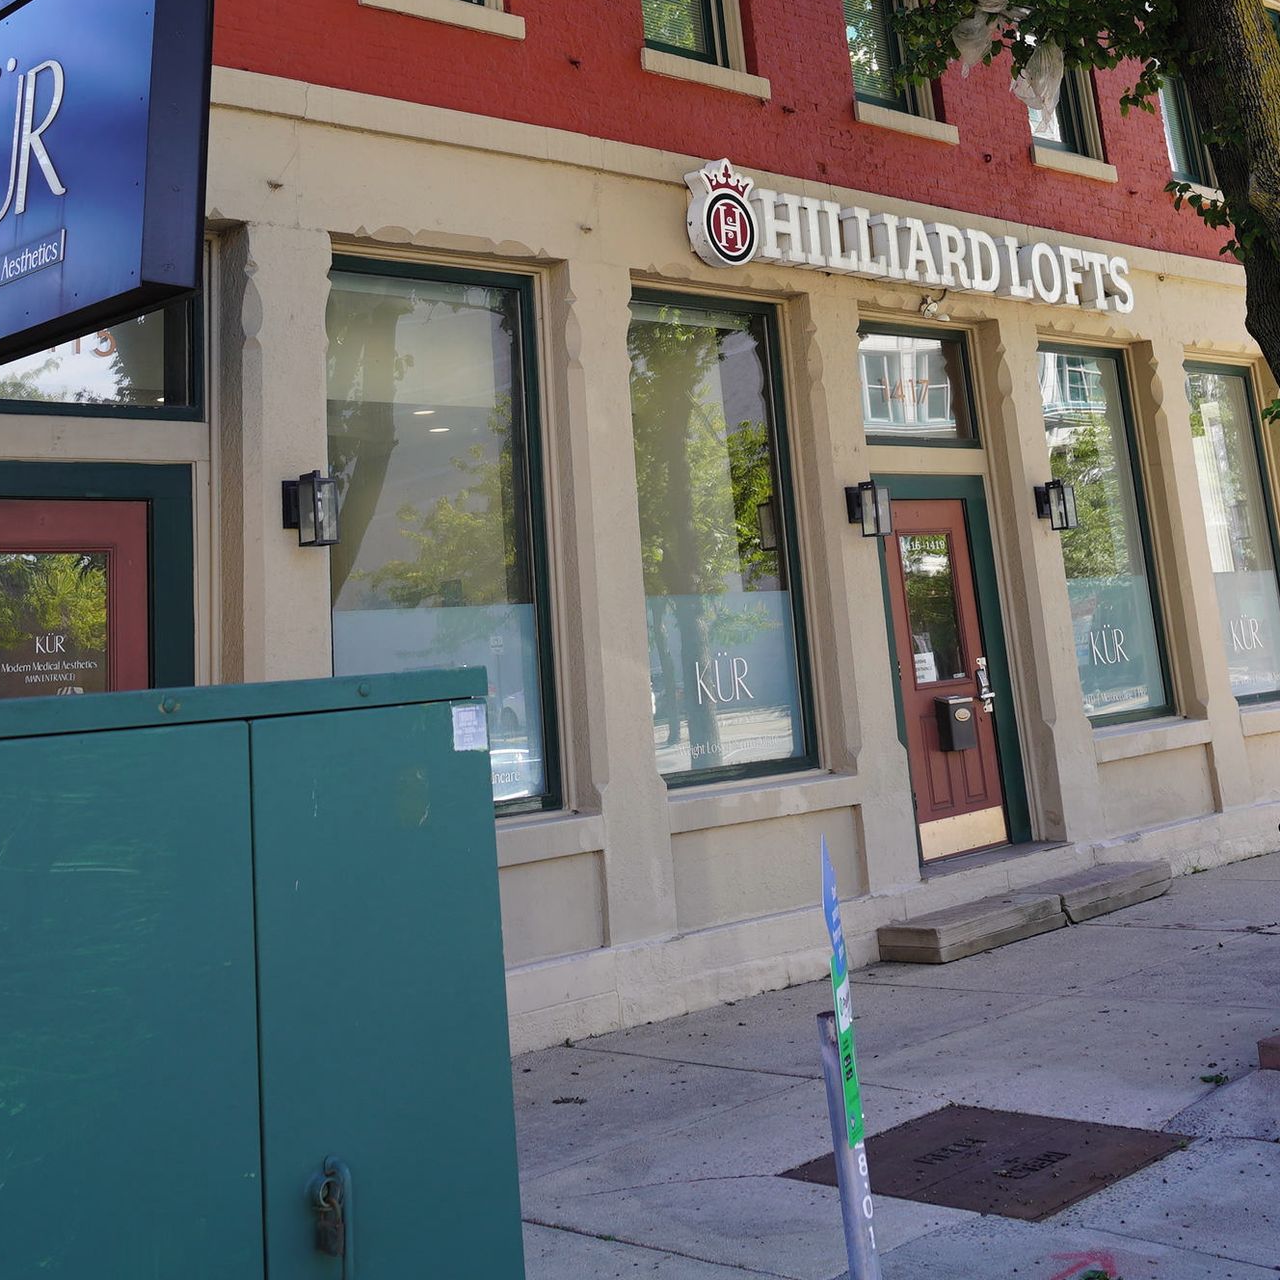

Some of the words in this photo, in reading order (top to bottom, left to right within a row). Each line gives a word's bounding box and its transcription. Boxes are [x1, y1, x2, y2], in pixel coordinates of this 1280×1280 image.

[0, 241, 59, 281] Aesthetics
[755, 188, 1001, 293] HILLIARD
[998, 235, 1134, 314] LOFTS
[35, 632, 66, 654] KÜR
[1089, 624, 1130, 666] KÜR
[1230, 614, 1264, 652] KÜR
[1, 663, 31, 673] Modern
[32, 660, 60, 671] Medical
[61, 659, 98, 670] Aesthetics
[695, 651, 754, 705] KÜR
